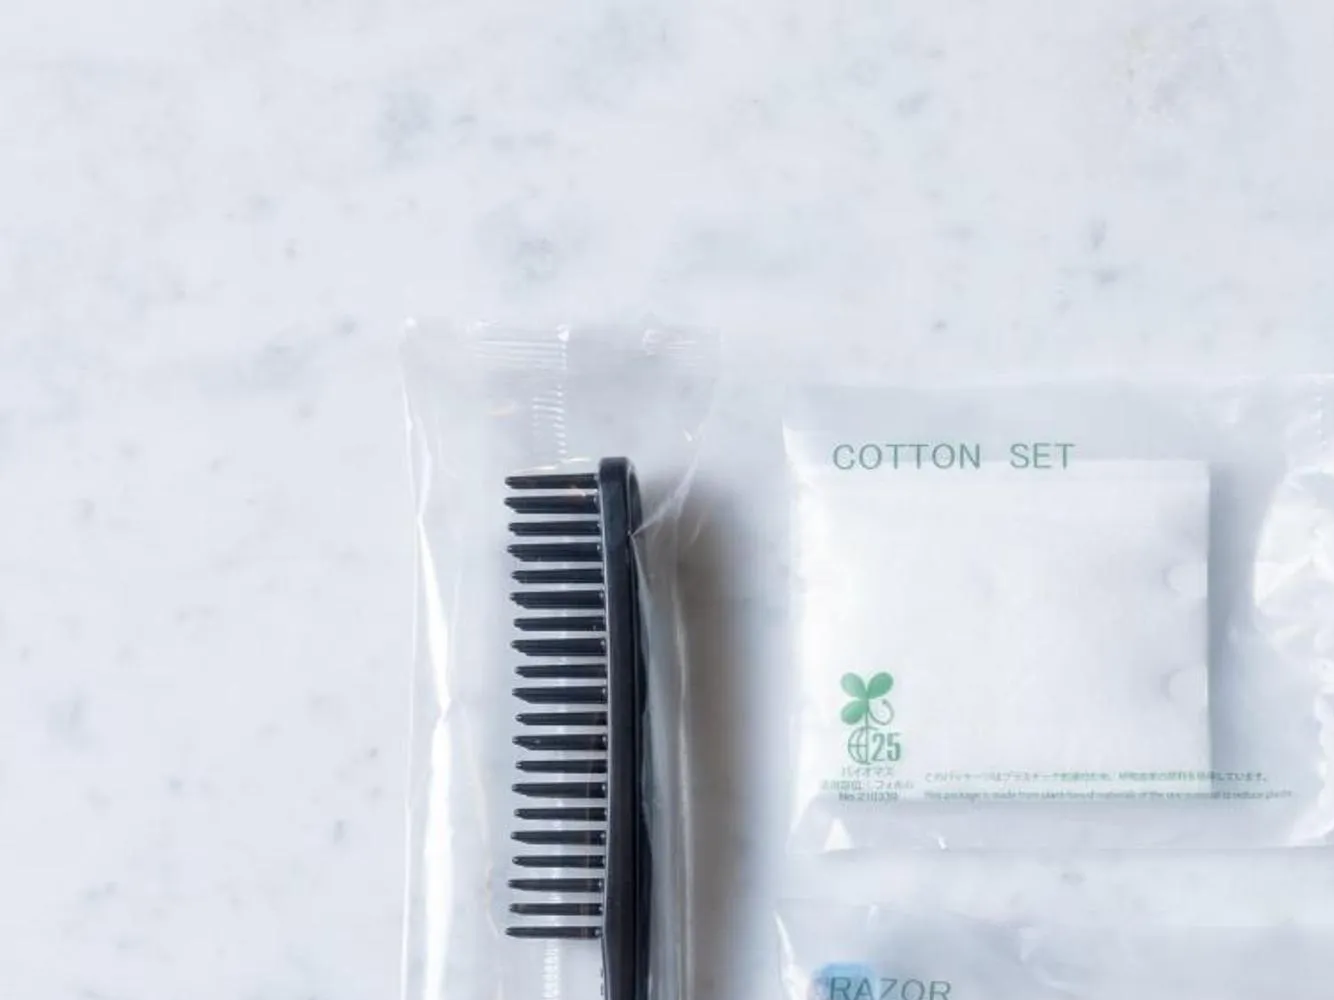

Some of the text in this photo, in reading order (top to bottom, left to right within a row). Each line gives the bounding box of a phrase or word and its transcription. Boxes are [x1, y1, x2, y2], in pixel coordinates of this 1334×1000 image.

[832, 442, 1076, 471] COTTON SET
[871, 732, 902, 762] 25
